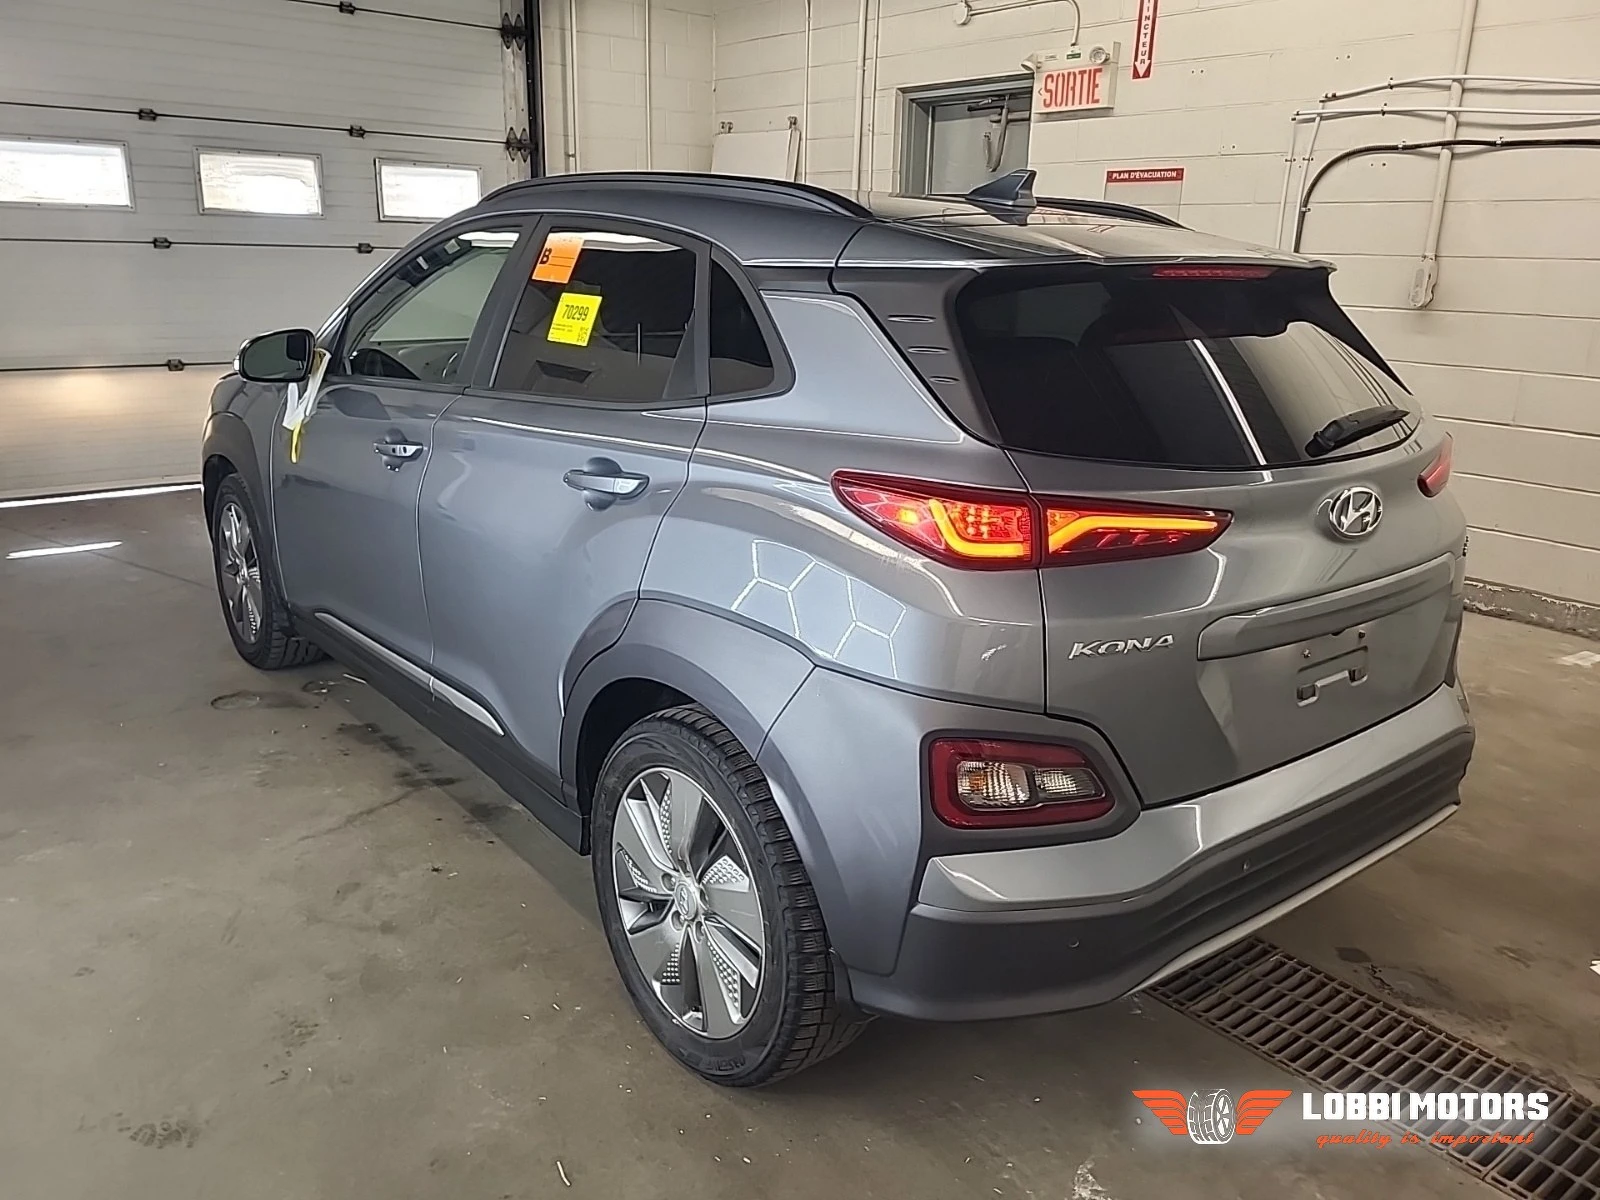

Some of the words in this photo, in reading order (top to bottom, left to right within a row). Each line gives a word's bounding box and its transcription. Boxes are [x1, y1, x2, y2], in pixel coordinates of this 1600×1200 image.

[1043, 67, 1102, 108] SORTIE
[1130, 170, 1177, 179] D'ÉVACUATION
[539, 247, 552, 264] B
[562, 304, 590, 321] 70299
[1068, 634, 1174, 660] KONA
